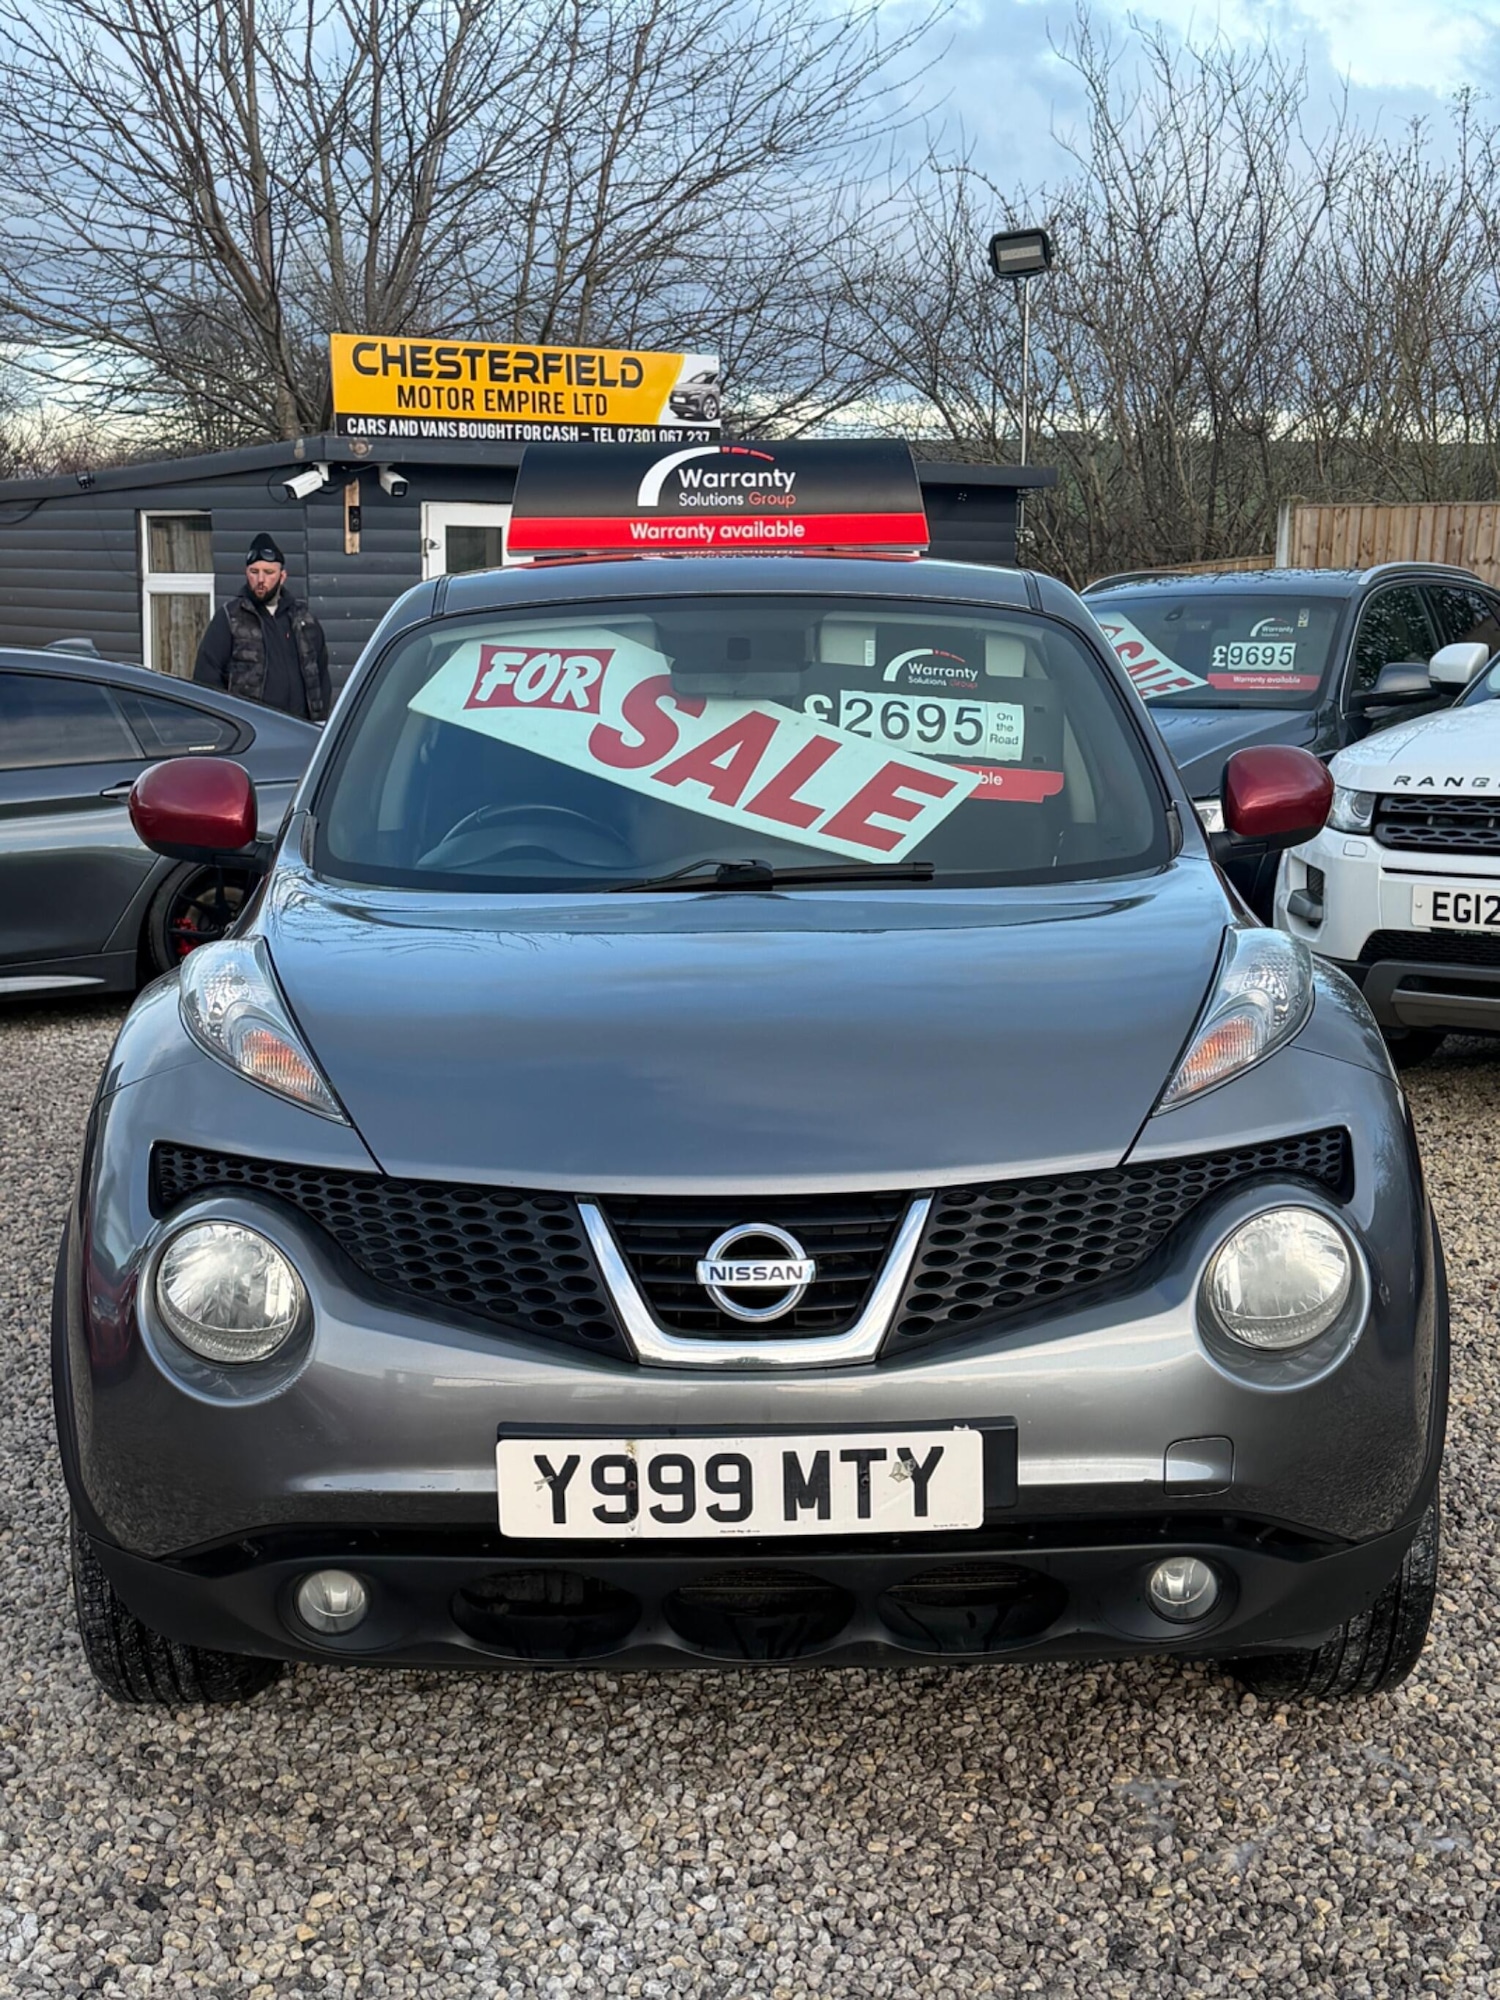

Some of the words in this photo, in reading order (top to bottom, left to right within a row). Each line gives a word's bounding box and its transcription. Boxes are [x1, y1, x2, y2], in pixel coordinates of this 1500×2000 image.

[352, 342, 643, 388] CHESTERFIELD
[397, 385, 475, 411] MOTOR
[484, 389, 566, 414] EMPIRE
[574, 393, 607, 416] LTD
[347, 418, 386, 435] CARS
[389, 419, 418, 437] AND
[420, 421, 457, 438] VANS
[459, 423, 513, 440] BOUGHT
[515, 424, 541, 441] FOR
[542, 426, 579, 442] CASH
[592, 427, 615, 442] TEL
[618, 428, 656, 443] 07301
[678, 468, 796, 493] Warranty
[679, 492, 744, 506] Solutions
[748, 491, 796, 508] Group
[630, 522, 715, 543] Warranty
[720, 520, 805, 538] available
[1262, 626, 1294, 634] Warranty
[1212, 645, 1293, 667] £9695
[475, 651, 602, 709] FOR
[908, 662, 978, 682] Warranty
[908, 676, 947, 686] Solutions
[1233, 676, 1265, 684] Warranty
[1267, 675, 1300, 684] available
[803, 694, 984, 746] £2695
[996, 712, 1013, 721] On
[996, 723, 1014, 732] the
[989, 733, 1019, 745] Road
[588, 674, 959, 854] SALE
[1394, 775, 1500, 788] RANG
[709, 1266, 803, 1281] NISSAN
[534, 1452, 753, 1525] Y999
[782, 1446, 944, 1522] MTY
